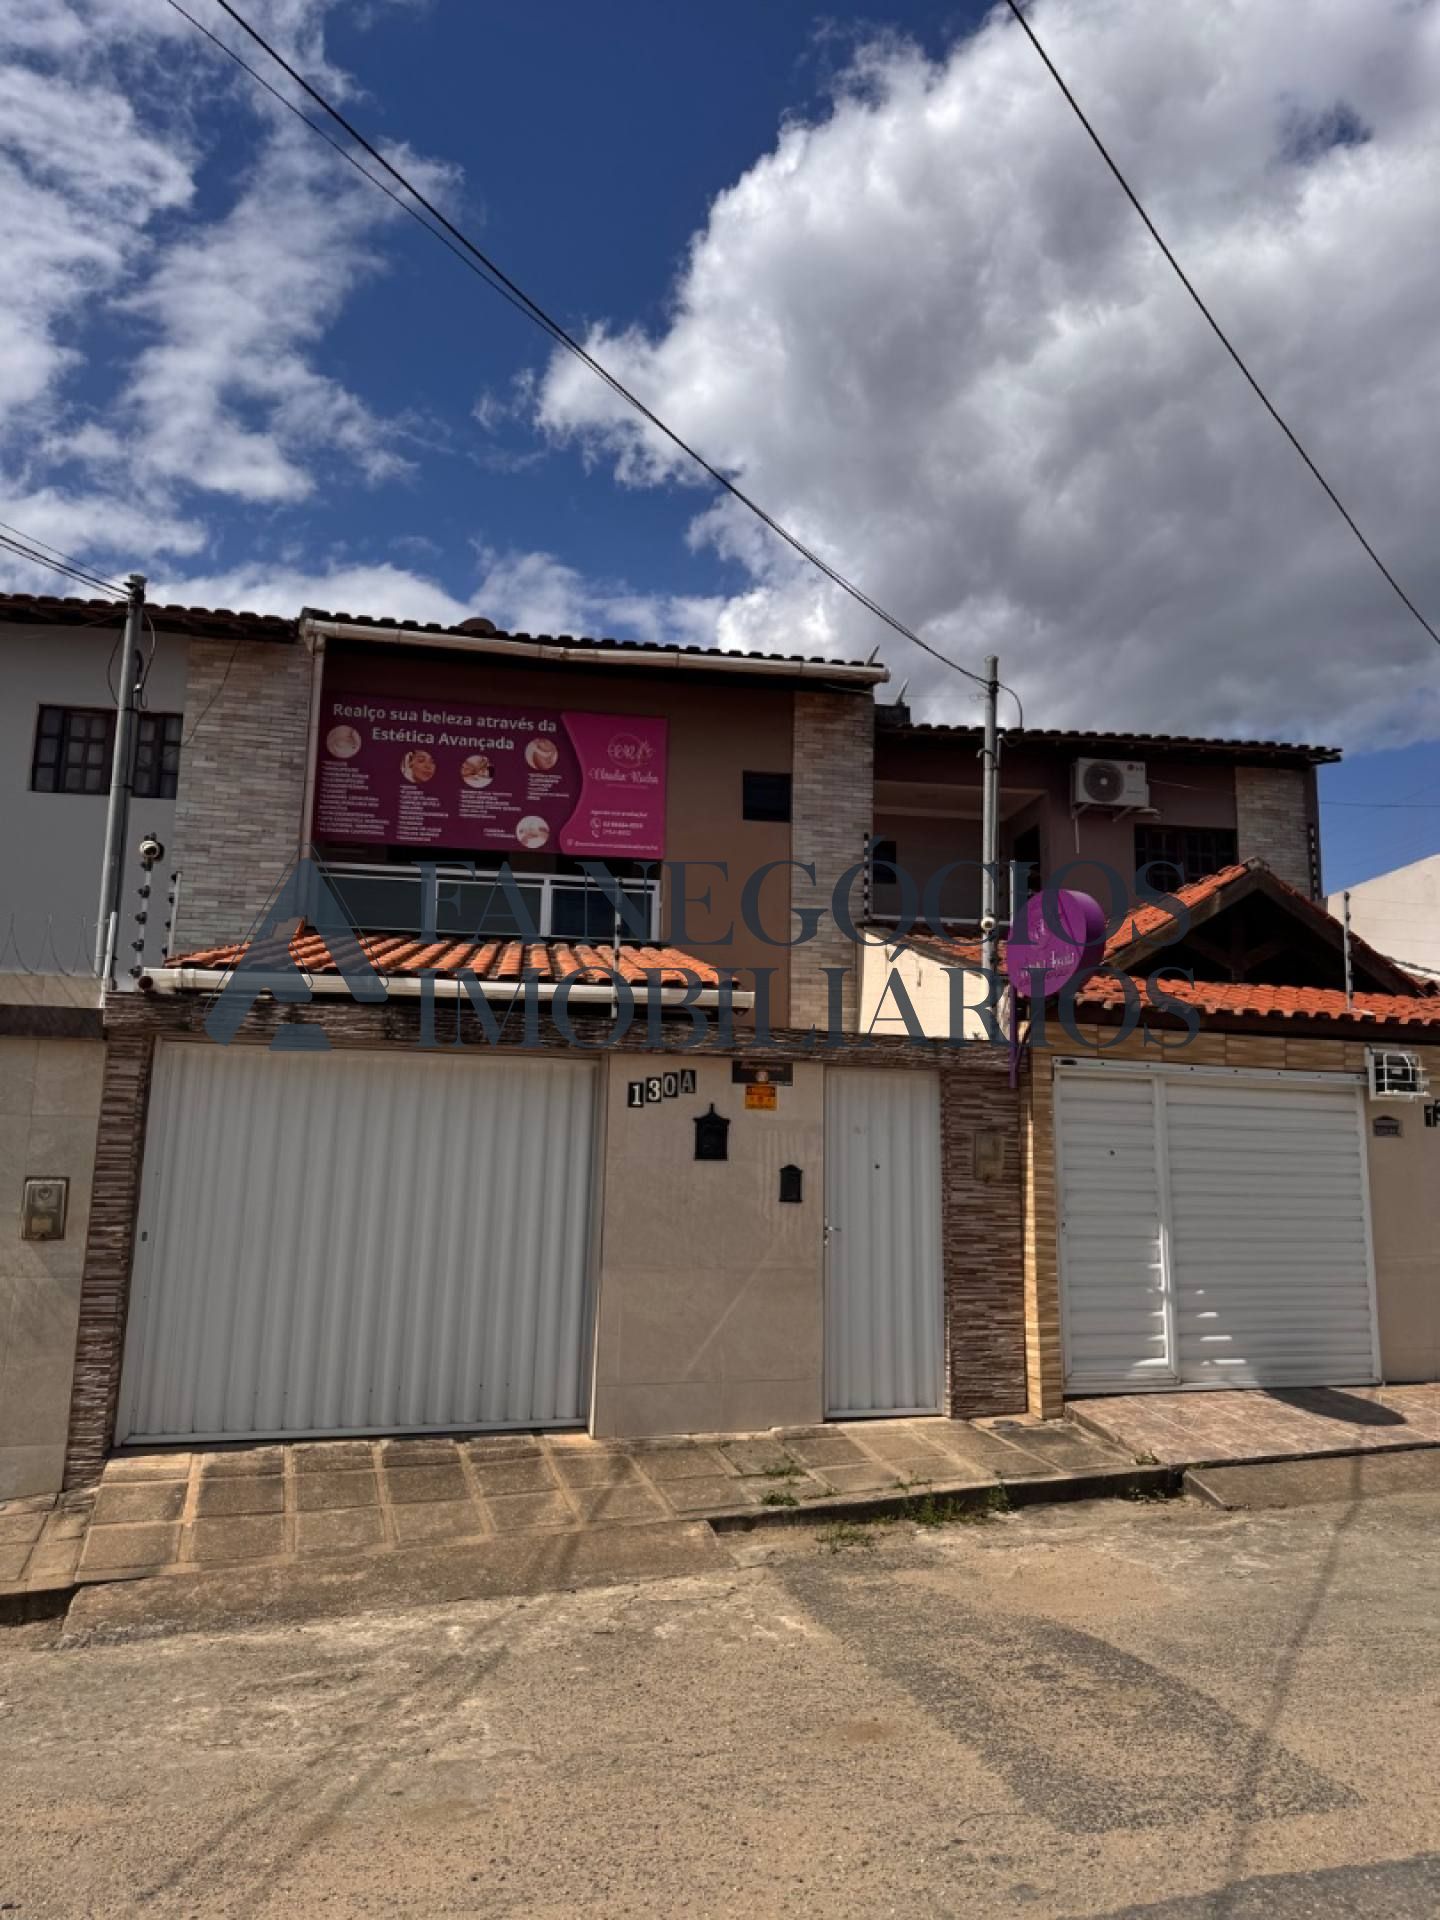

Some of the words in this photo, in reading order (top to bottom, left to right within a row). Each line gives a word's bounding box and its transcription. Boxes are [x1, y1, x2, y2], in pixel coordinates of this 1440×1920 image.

[390, 709, 418, 722] sua
[422, 709, 473, 727] beleza
[476, 714, 535, 731] através
[538, 719, 558, 733] da
[372, 727, 436, 745] Estética
[438, 731, 516, 751] Avançada
[631, 1070, 696, 1107] 130A
